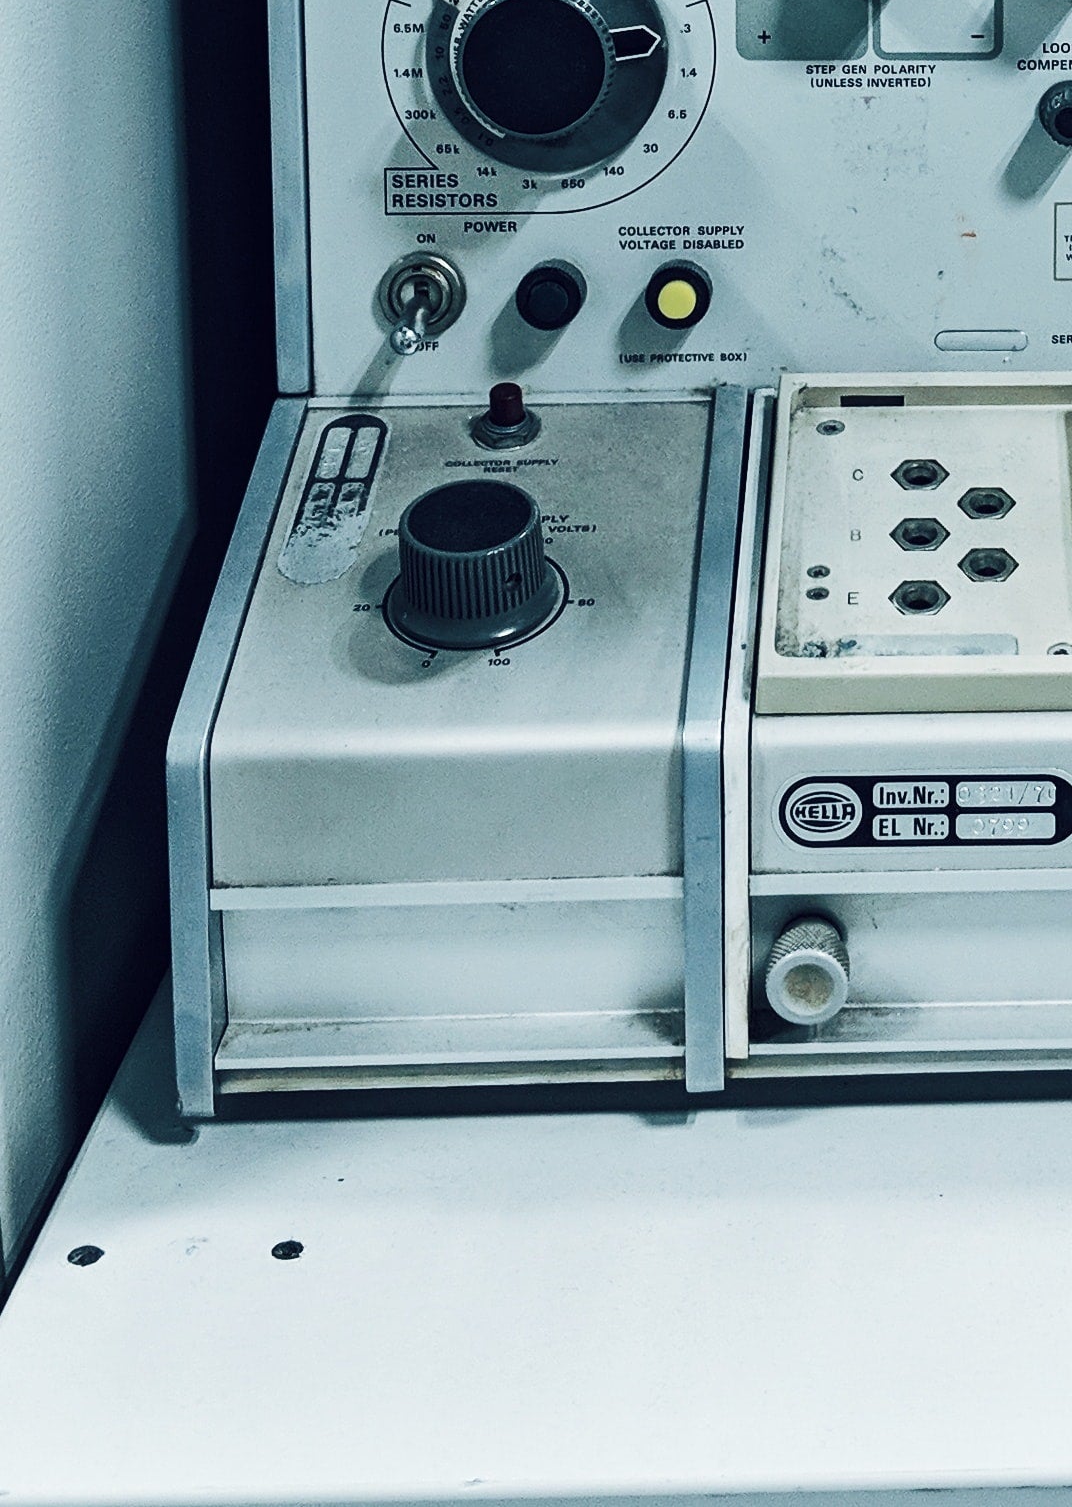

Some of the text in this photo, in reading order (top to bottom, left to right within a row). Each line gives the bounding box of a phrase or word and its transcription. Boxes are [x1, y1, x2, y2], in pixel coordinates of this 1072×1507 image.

[806, 65, 936, 74] STEP GEN POLARITY
[810, 77, 931, 87] (UNLESS INVERTED)
[392, 173, 458, 188] SERIES
[392, 193, 497, 208] RESISTORS
[464, 221, 517, 233] POWER
[619, 226, 744, 237] COLLECTOR SUPPLY
[417, 234, 435, 243] ON
[619, 239, 744, 250] VOLTAGE DISABLED
[619, 353, 747, 363] (USE PROTECTIVE BOX)
[796, 803, 855, 821] HELLA
[879, 818, 945, 836] EL Nr.:
